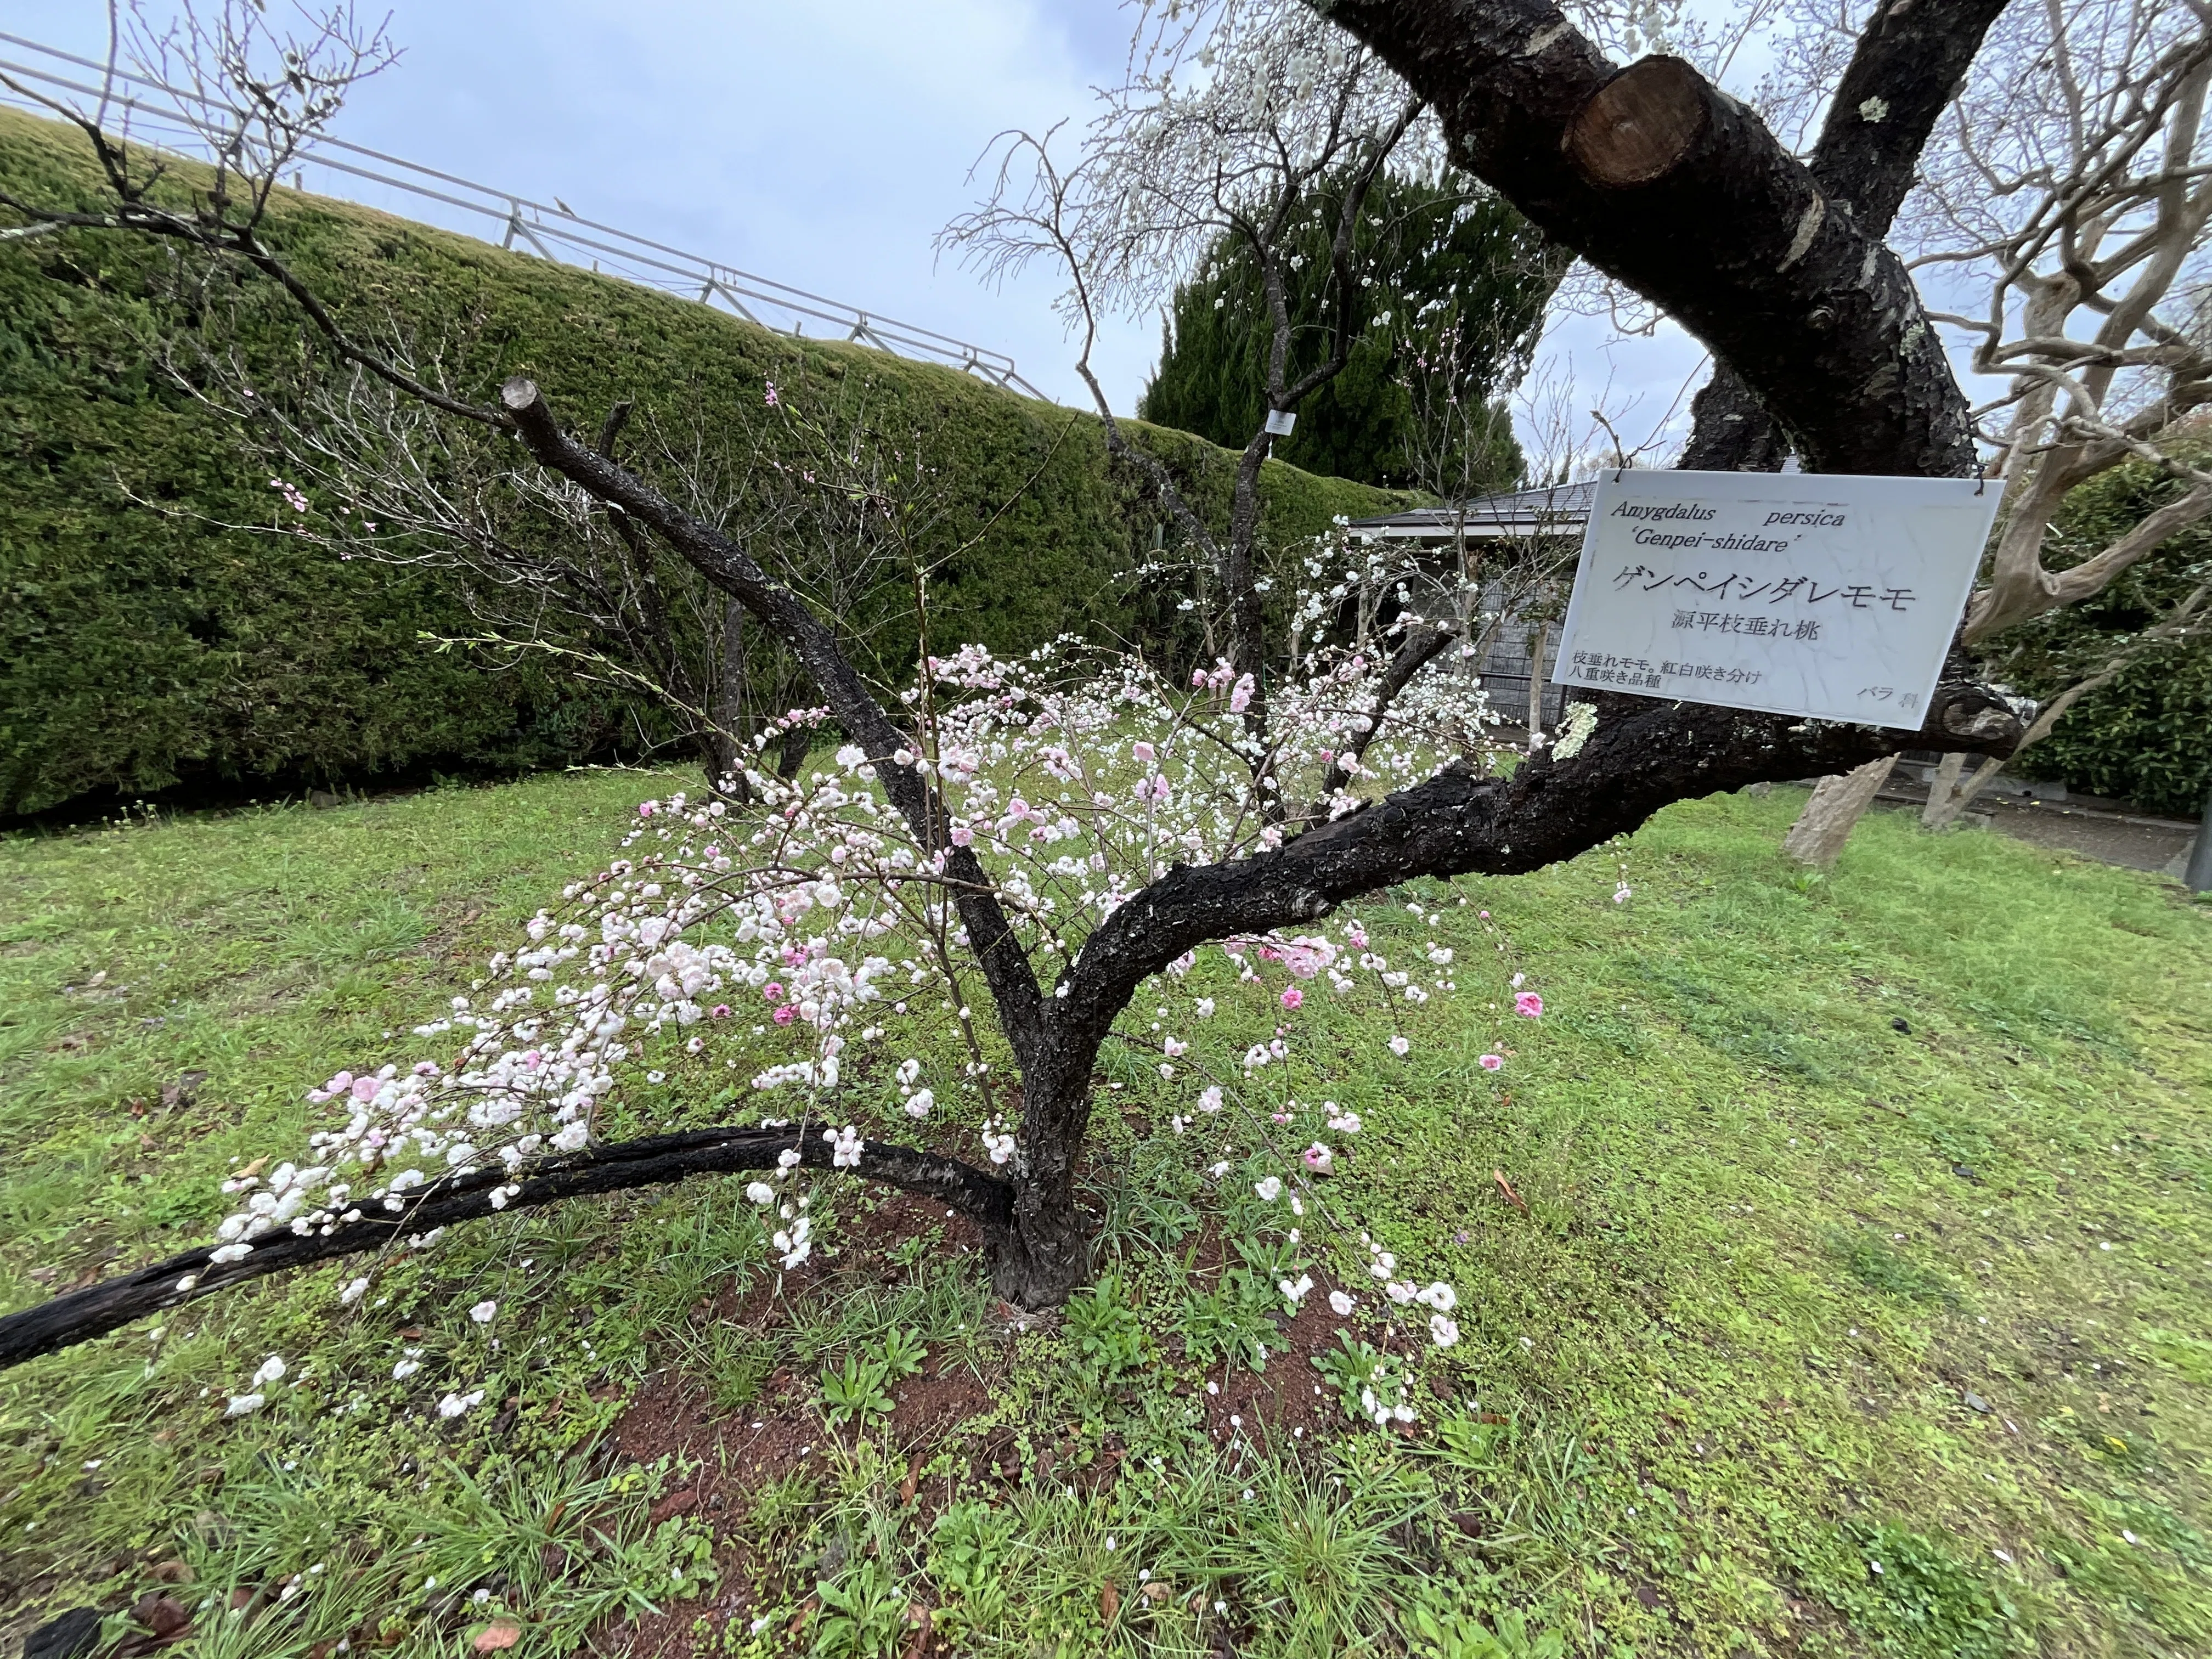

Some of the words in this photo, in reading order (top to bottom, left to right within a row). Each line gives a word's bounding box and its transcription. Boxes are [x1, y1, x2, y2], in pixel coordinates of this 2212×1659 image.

[1611, 500, 1716, 521] Amygdalus
[1762, 509, 1845, 526] persica
[1612, 565, 1916, 611] ゲンペイシダレモモ
[1671, 609, 1820, 640] 源平枝垂れ桃
[1568, 665, 1661, 689] 八重咲き品種
